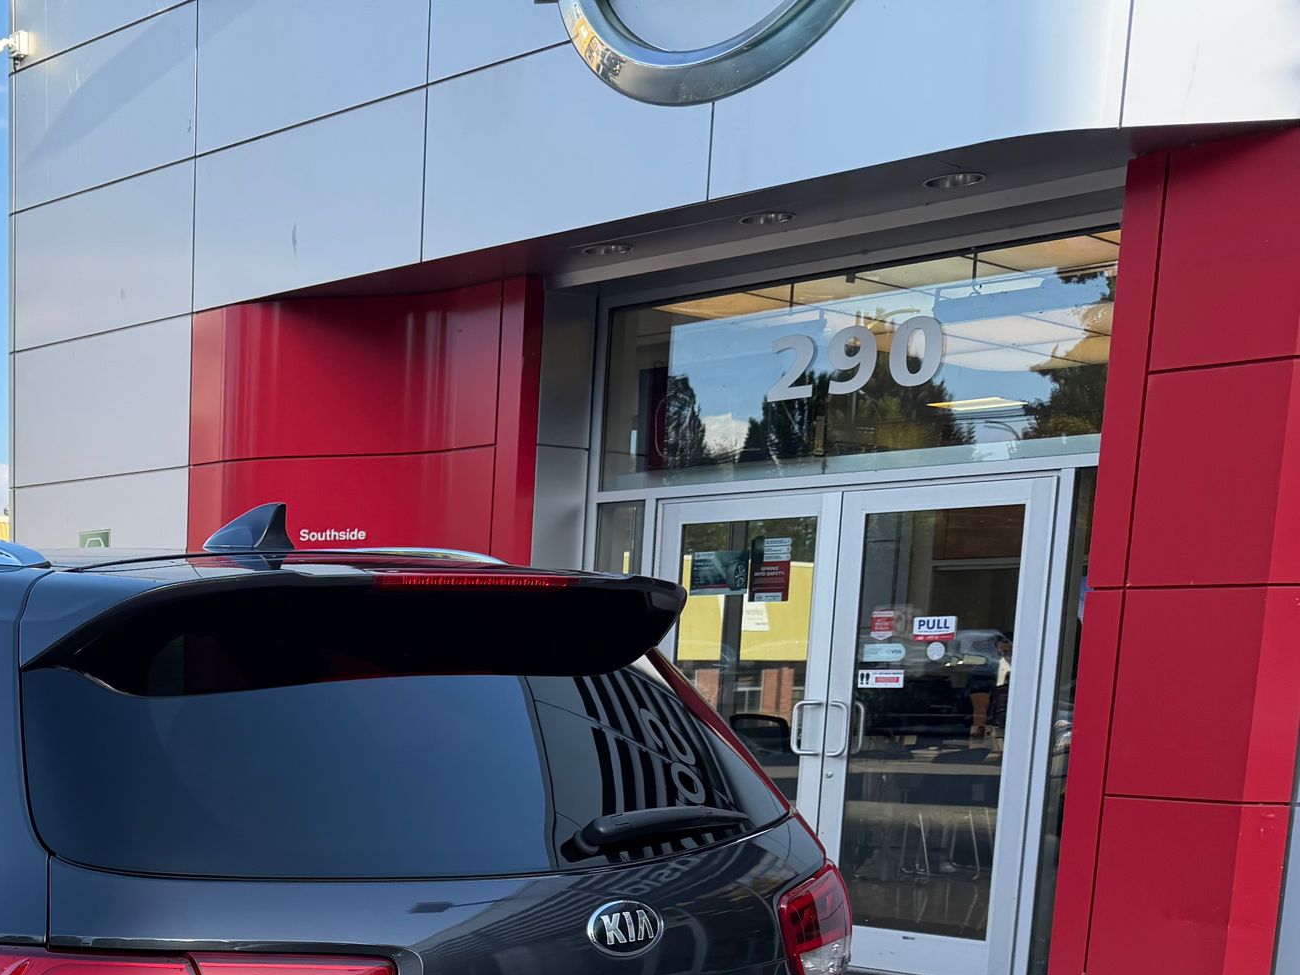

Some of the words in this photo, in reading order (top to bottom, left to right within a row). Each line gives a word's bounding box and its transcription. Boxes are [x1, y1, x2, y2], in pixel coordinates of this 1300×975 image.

[767, 316, 945, 402] 290
[299, 528, 366, 541] Southside
[917, 618, 950, 630] PULL
[600, 909, 655, 946] KIA
